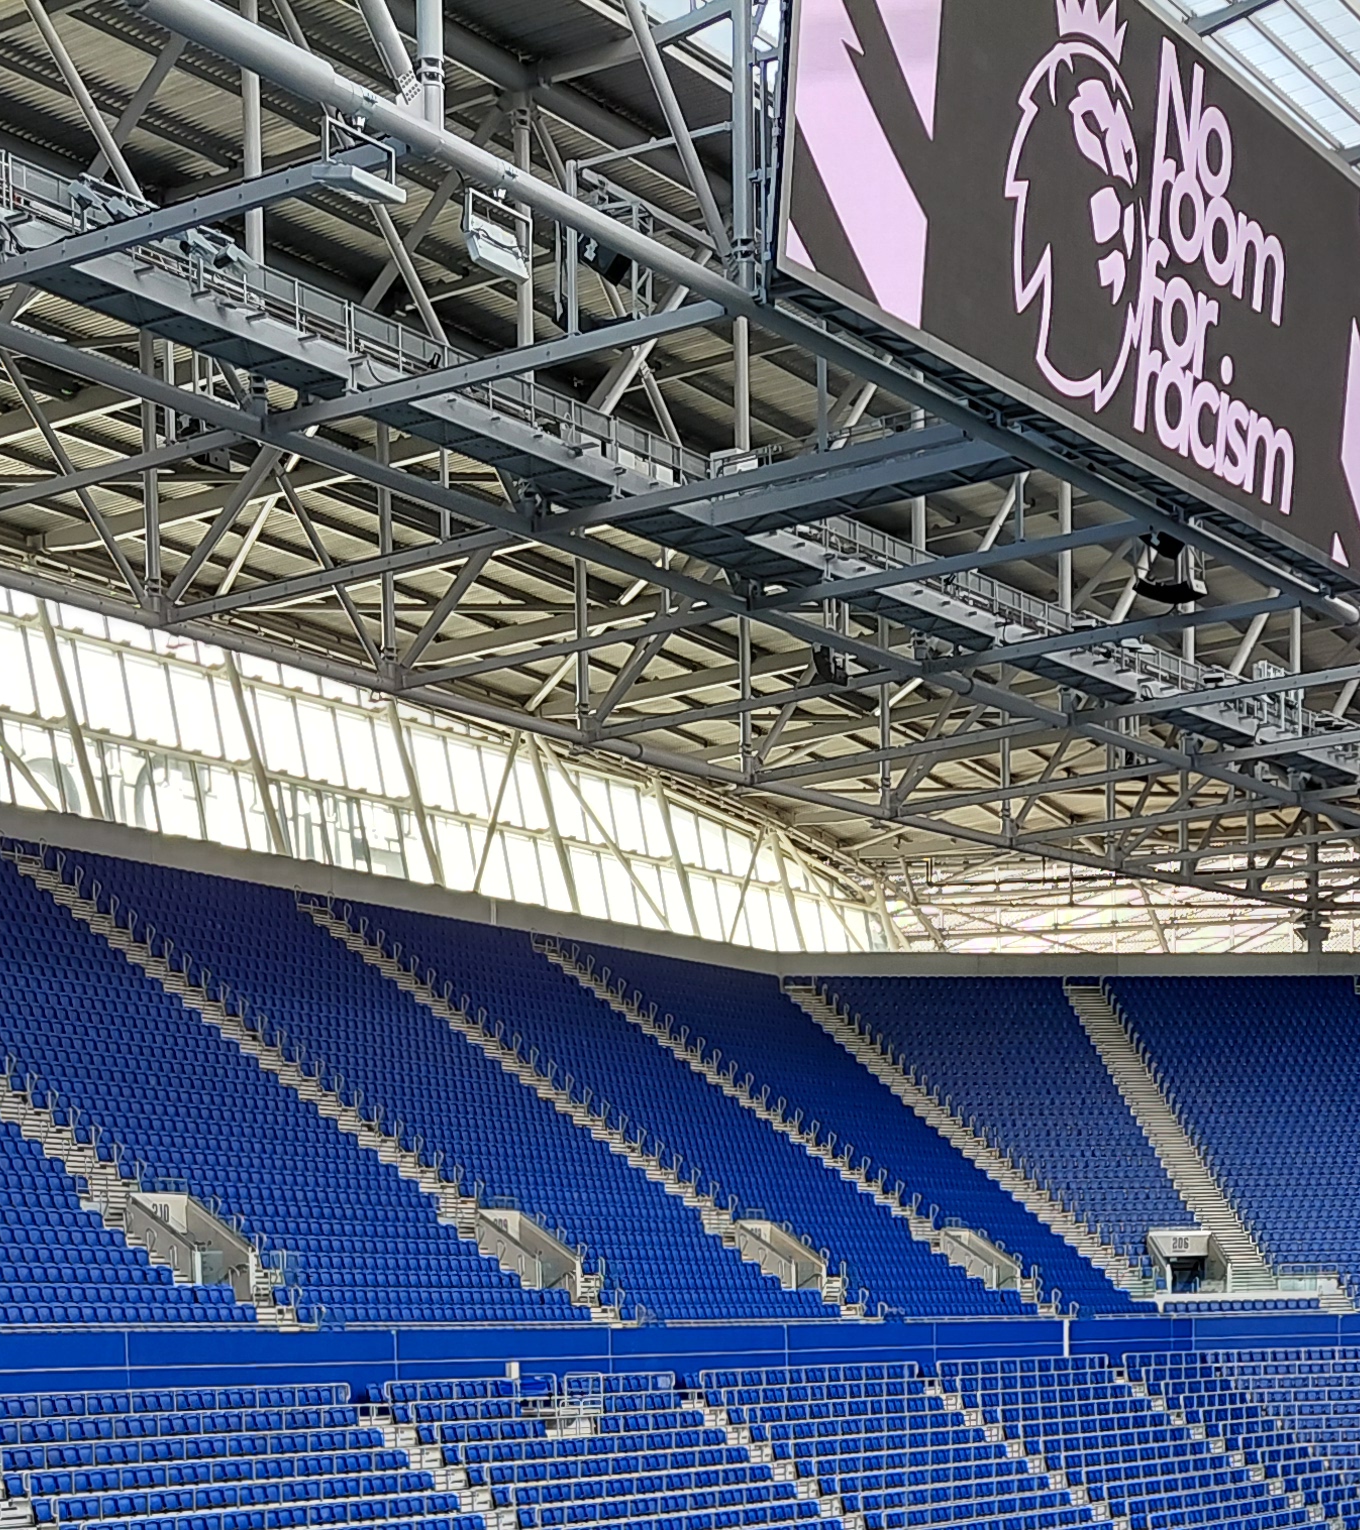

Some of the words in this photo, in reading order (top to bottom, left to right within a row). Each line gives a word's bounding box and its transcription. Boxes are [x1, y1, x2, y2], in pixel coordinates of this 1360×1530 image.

[1160, 36, 1233, 200] No
[1142, 237, 1219, 383] for
[1149, 158, 1286, 326] room
[1134, 355, 1295, 516] racism
[1172, 1237, 1189, 1249] 206
